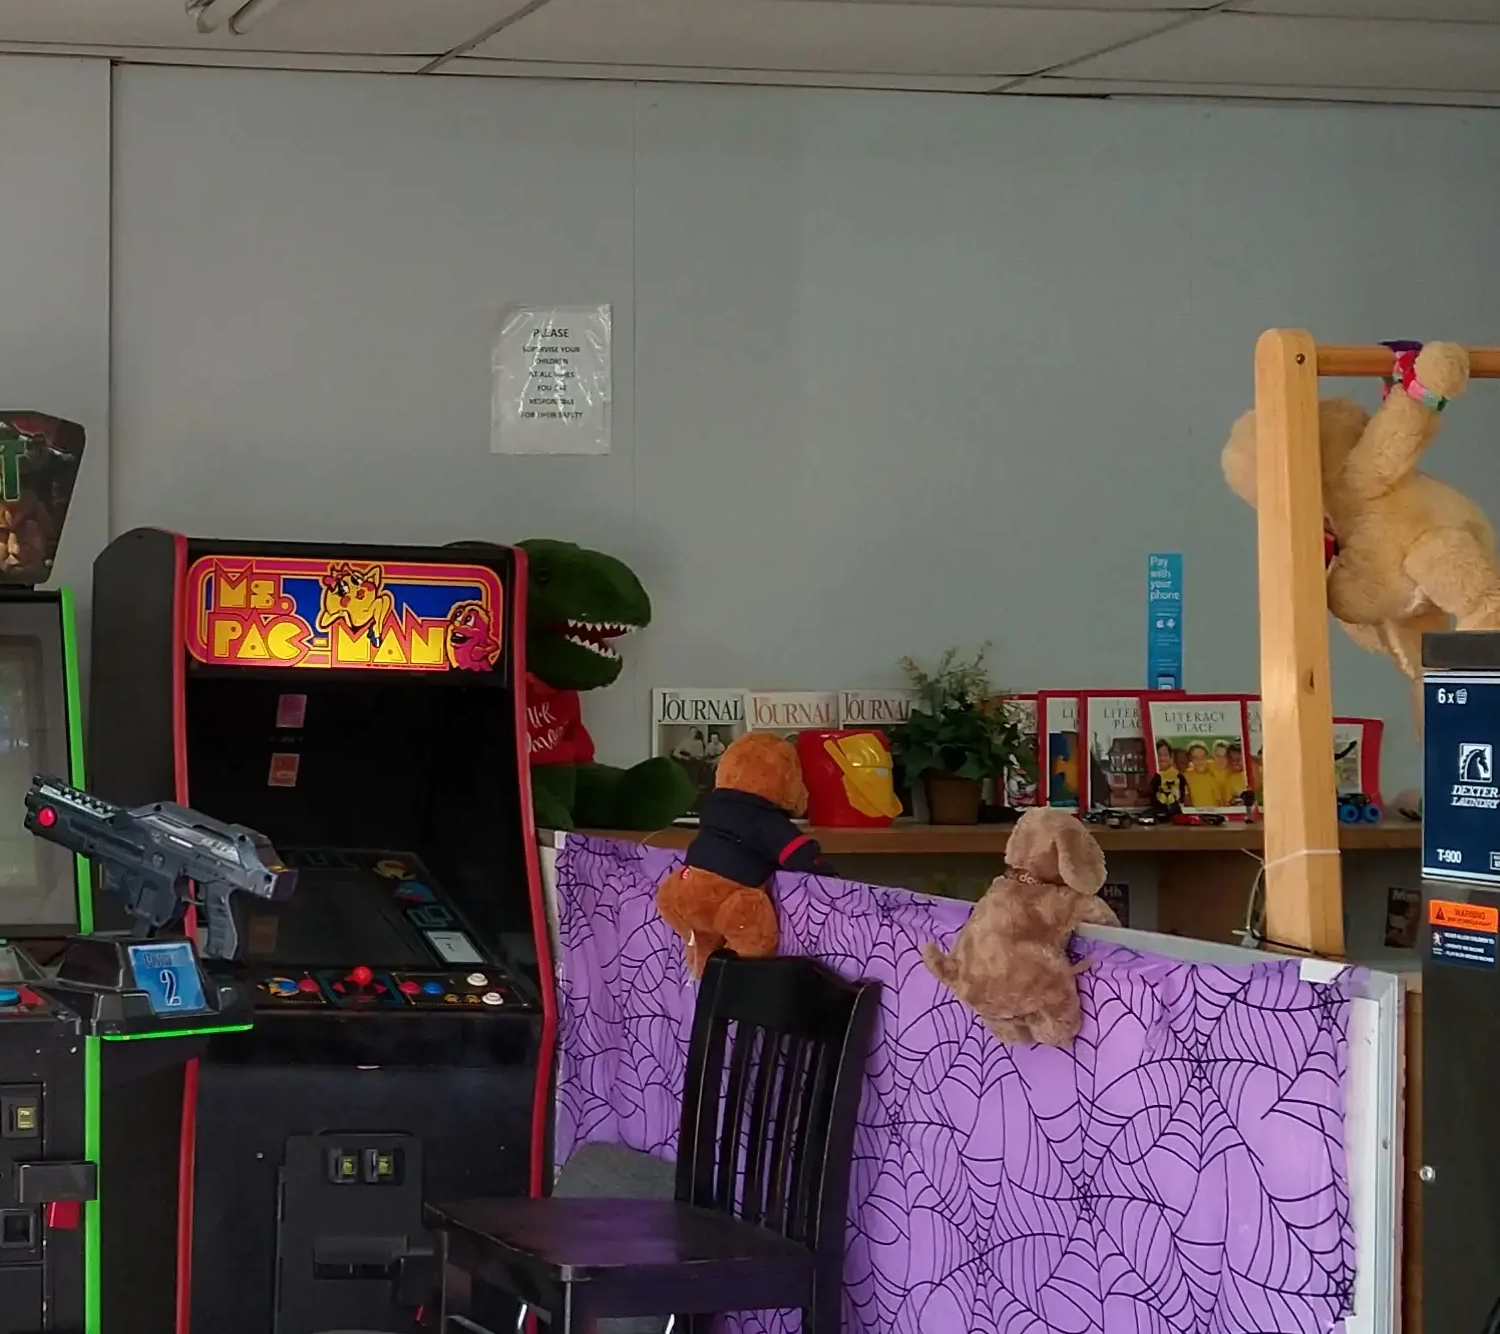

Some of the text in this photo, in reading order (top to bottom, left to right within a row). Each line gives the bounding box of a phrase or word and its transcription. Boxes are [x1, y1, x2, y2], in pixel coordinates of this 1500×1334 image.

[1150, 555, 1169, 568] Pay
[1150, 580, 1173, 591] your
[1150, 588, 1181, 602] phone
[213, 617, 445, 666] PAC-MAN
[658, 692, 744, 722] JOURNAL
[752, 697, 837, 725] JOURNAL
[1164, 711, 1226, 723] LITERACY
[1176, 722, 1215, 733] PLACE
[1451, 784, 1499, 798] DEXTER
[1451, 796, 1500, 809] LAUNDRY
[1437, 848, 1462, 864] T-900
[160, 969, 182, 1006] 2
